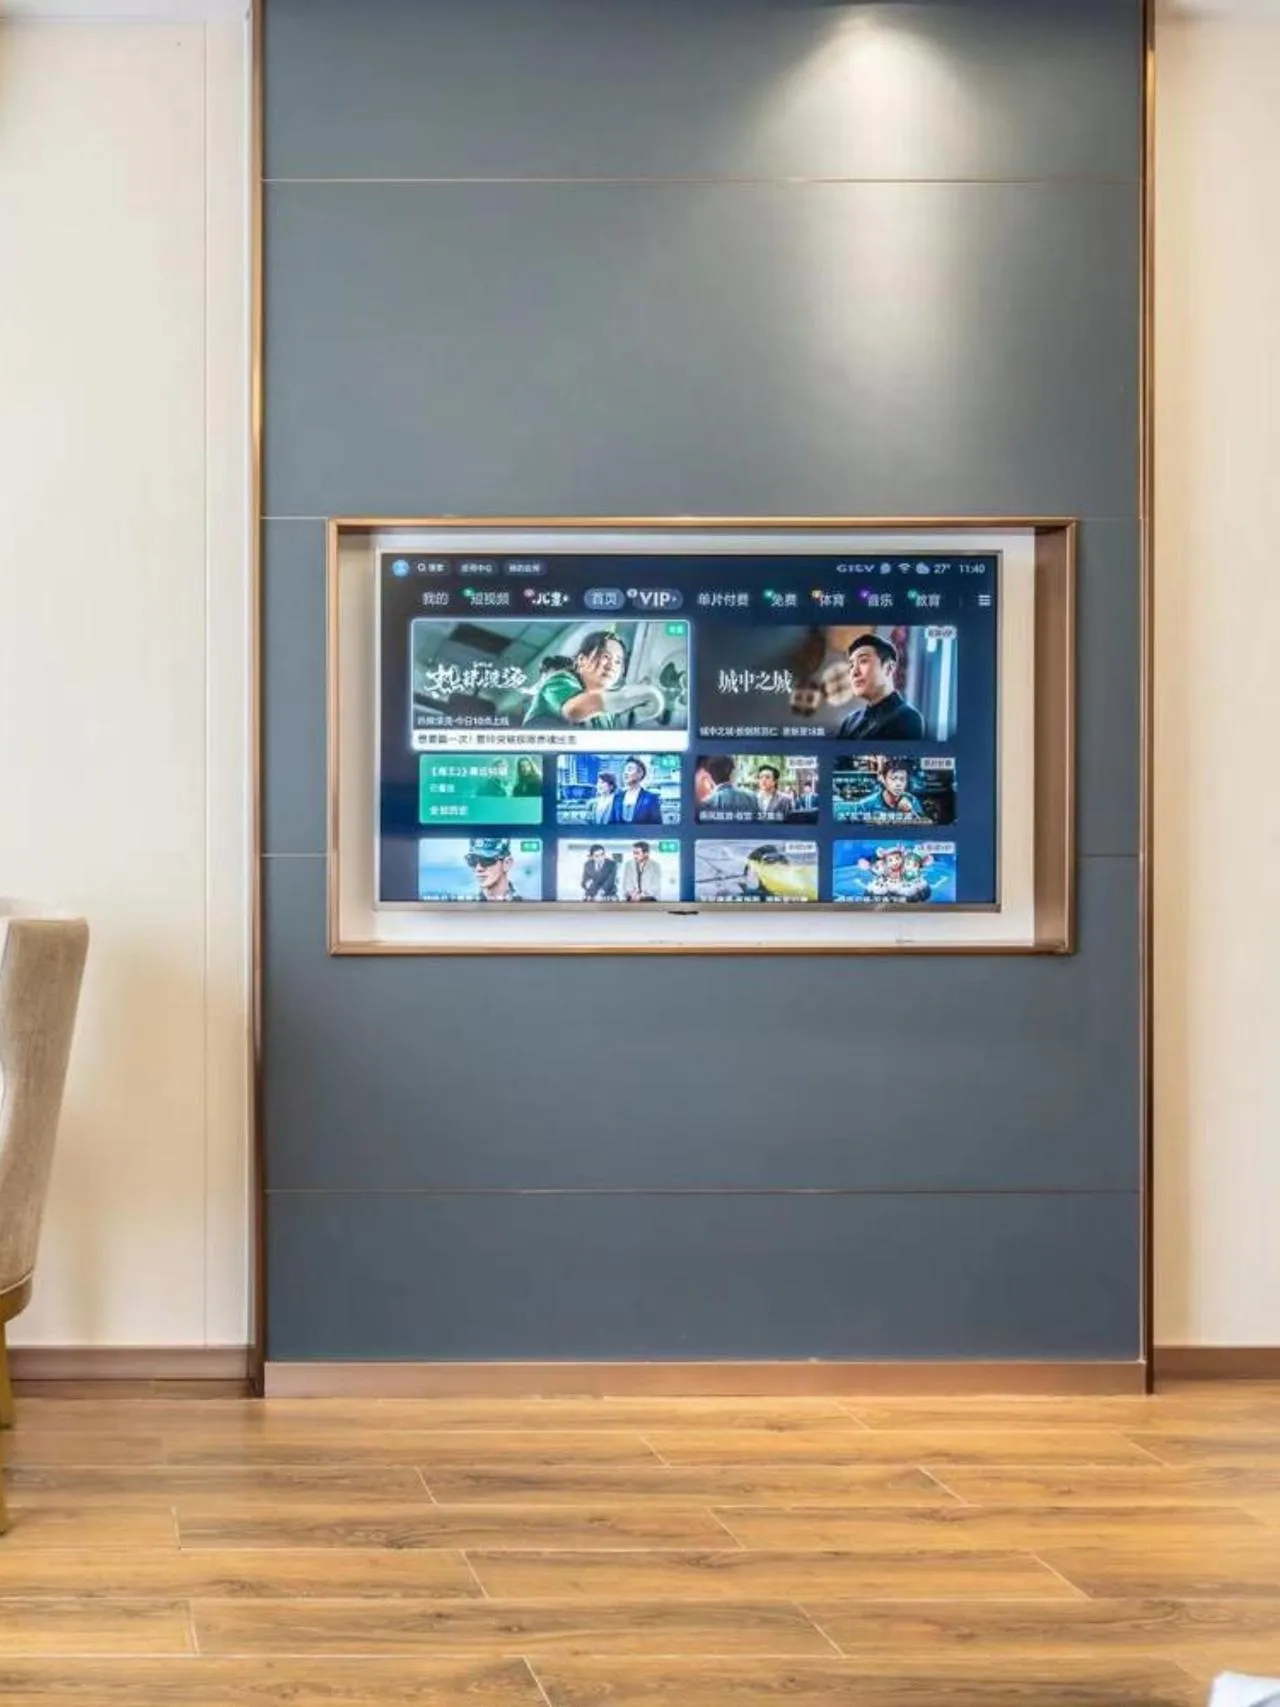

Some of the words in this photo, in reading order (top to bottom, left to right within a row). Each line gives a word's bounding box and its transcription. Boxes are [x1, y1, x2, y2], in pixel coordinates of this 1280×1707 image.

[959, 563, 986, 574] 11:40
[422, 592, 449, 606] 我的
[470, 591, 510, 606] 短视频
[591, 591, 617, 606] 首页
[638, 592, 672, 607] VIP
[696, 592, 749, 607] 单片付费
[771, 592, 798, 607] 免费
[819, 592, 845, 607] 体育
[867, 592, 894, 607] 音乐
[915, 592, 941, 607] 教育
[718, 668, 794, 694] 城中之城
